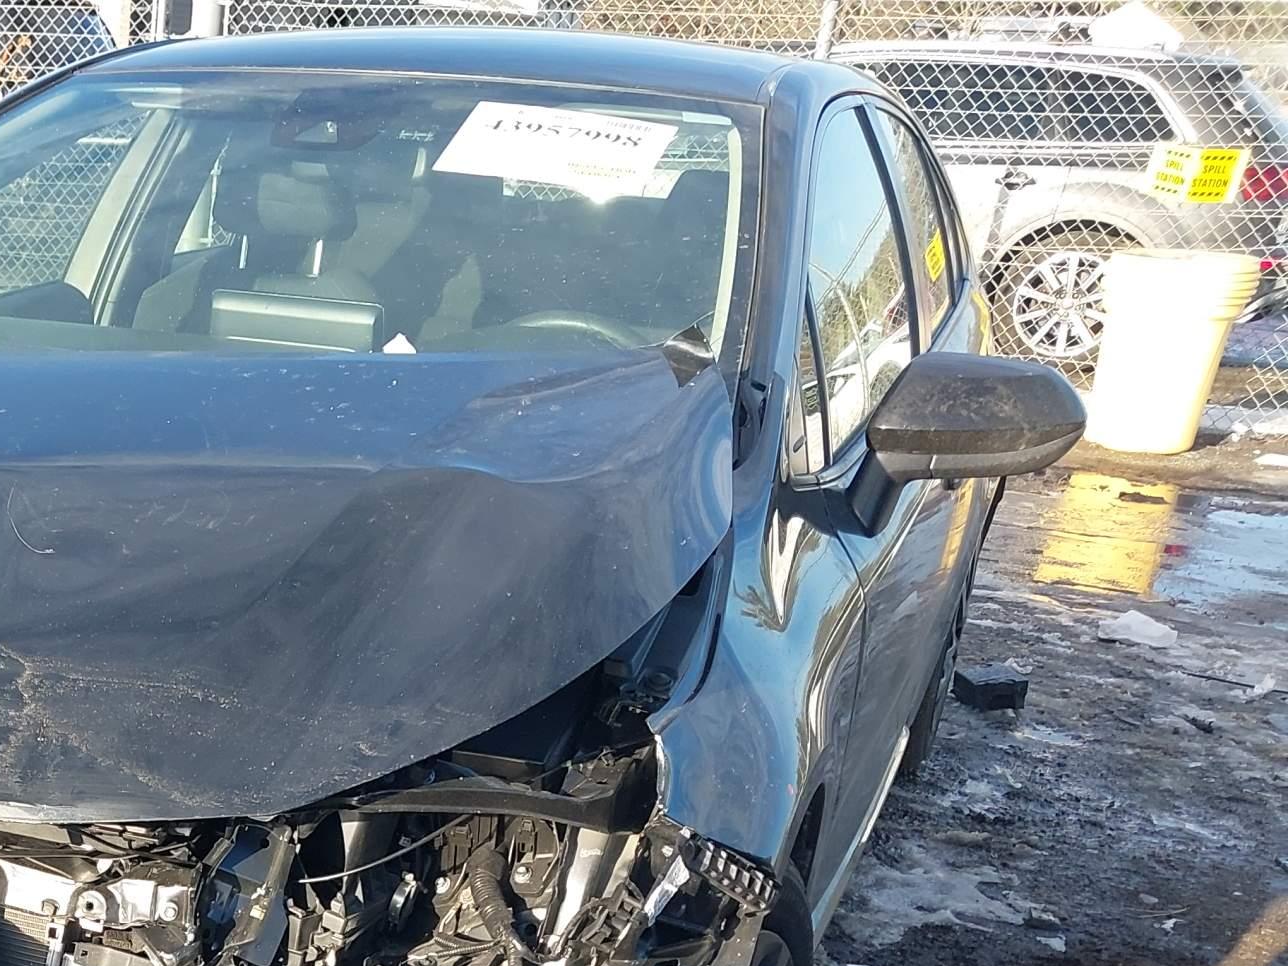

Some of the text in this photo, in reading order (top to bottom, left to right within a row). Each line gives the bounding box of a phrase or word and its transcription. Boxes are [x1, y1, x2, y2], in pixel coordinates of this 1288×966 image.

[1165, 159, 1184, 171] SPILL
[1202, 164, 1227, 175] SPILL
[1155, 171, 1186, 186] STATION
[1191, 178, 1229, 188] STATION
